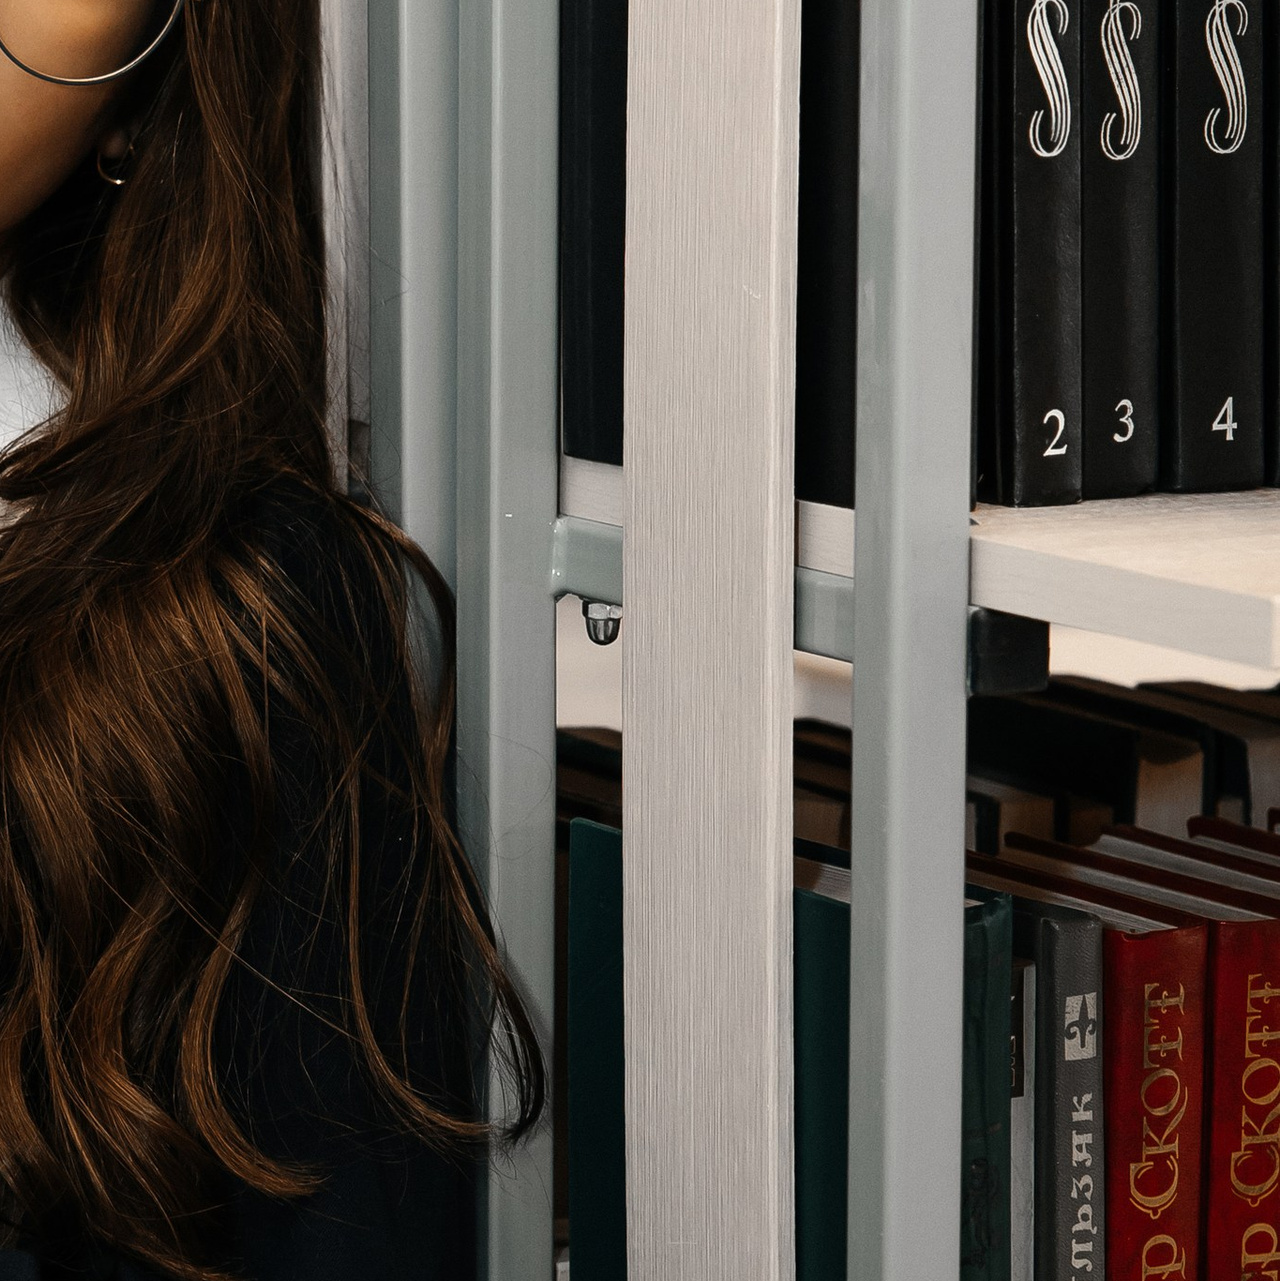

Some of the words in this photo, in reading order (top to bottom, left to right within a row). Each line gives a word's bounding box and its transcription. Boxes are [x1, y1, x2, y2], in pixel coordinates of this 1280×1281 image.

[1043, 408, 1068, 457] 2
[1113, 398, 1135, 443] 3
[1212, 396, 1238, 441] 4
[1129, 982, 1188, 1220] СКОТТ
